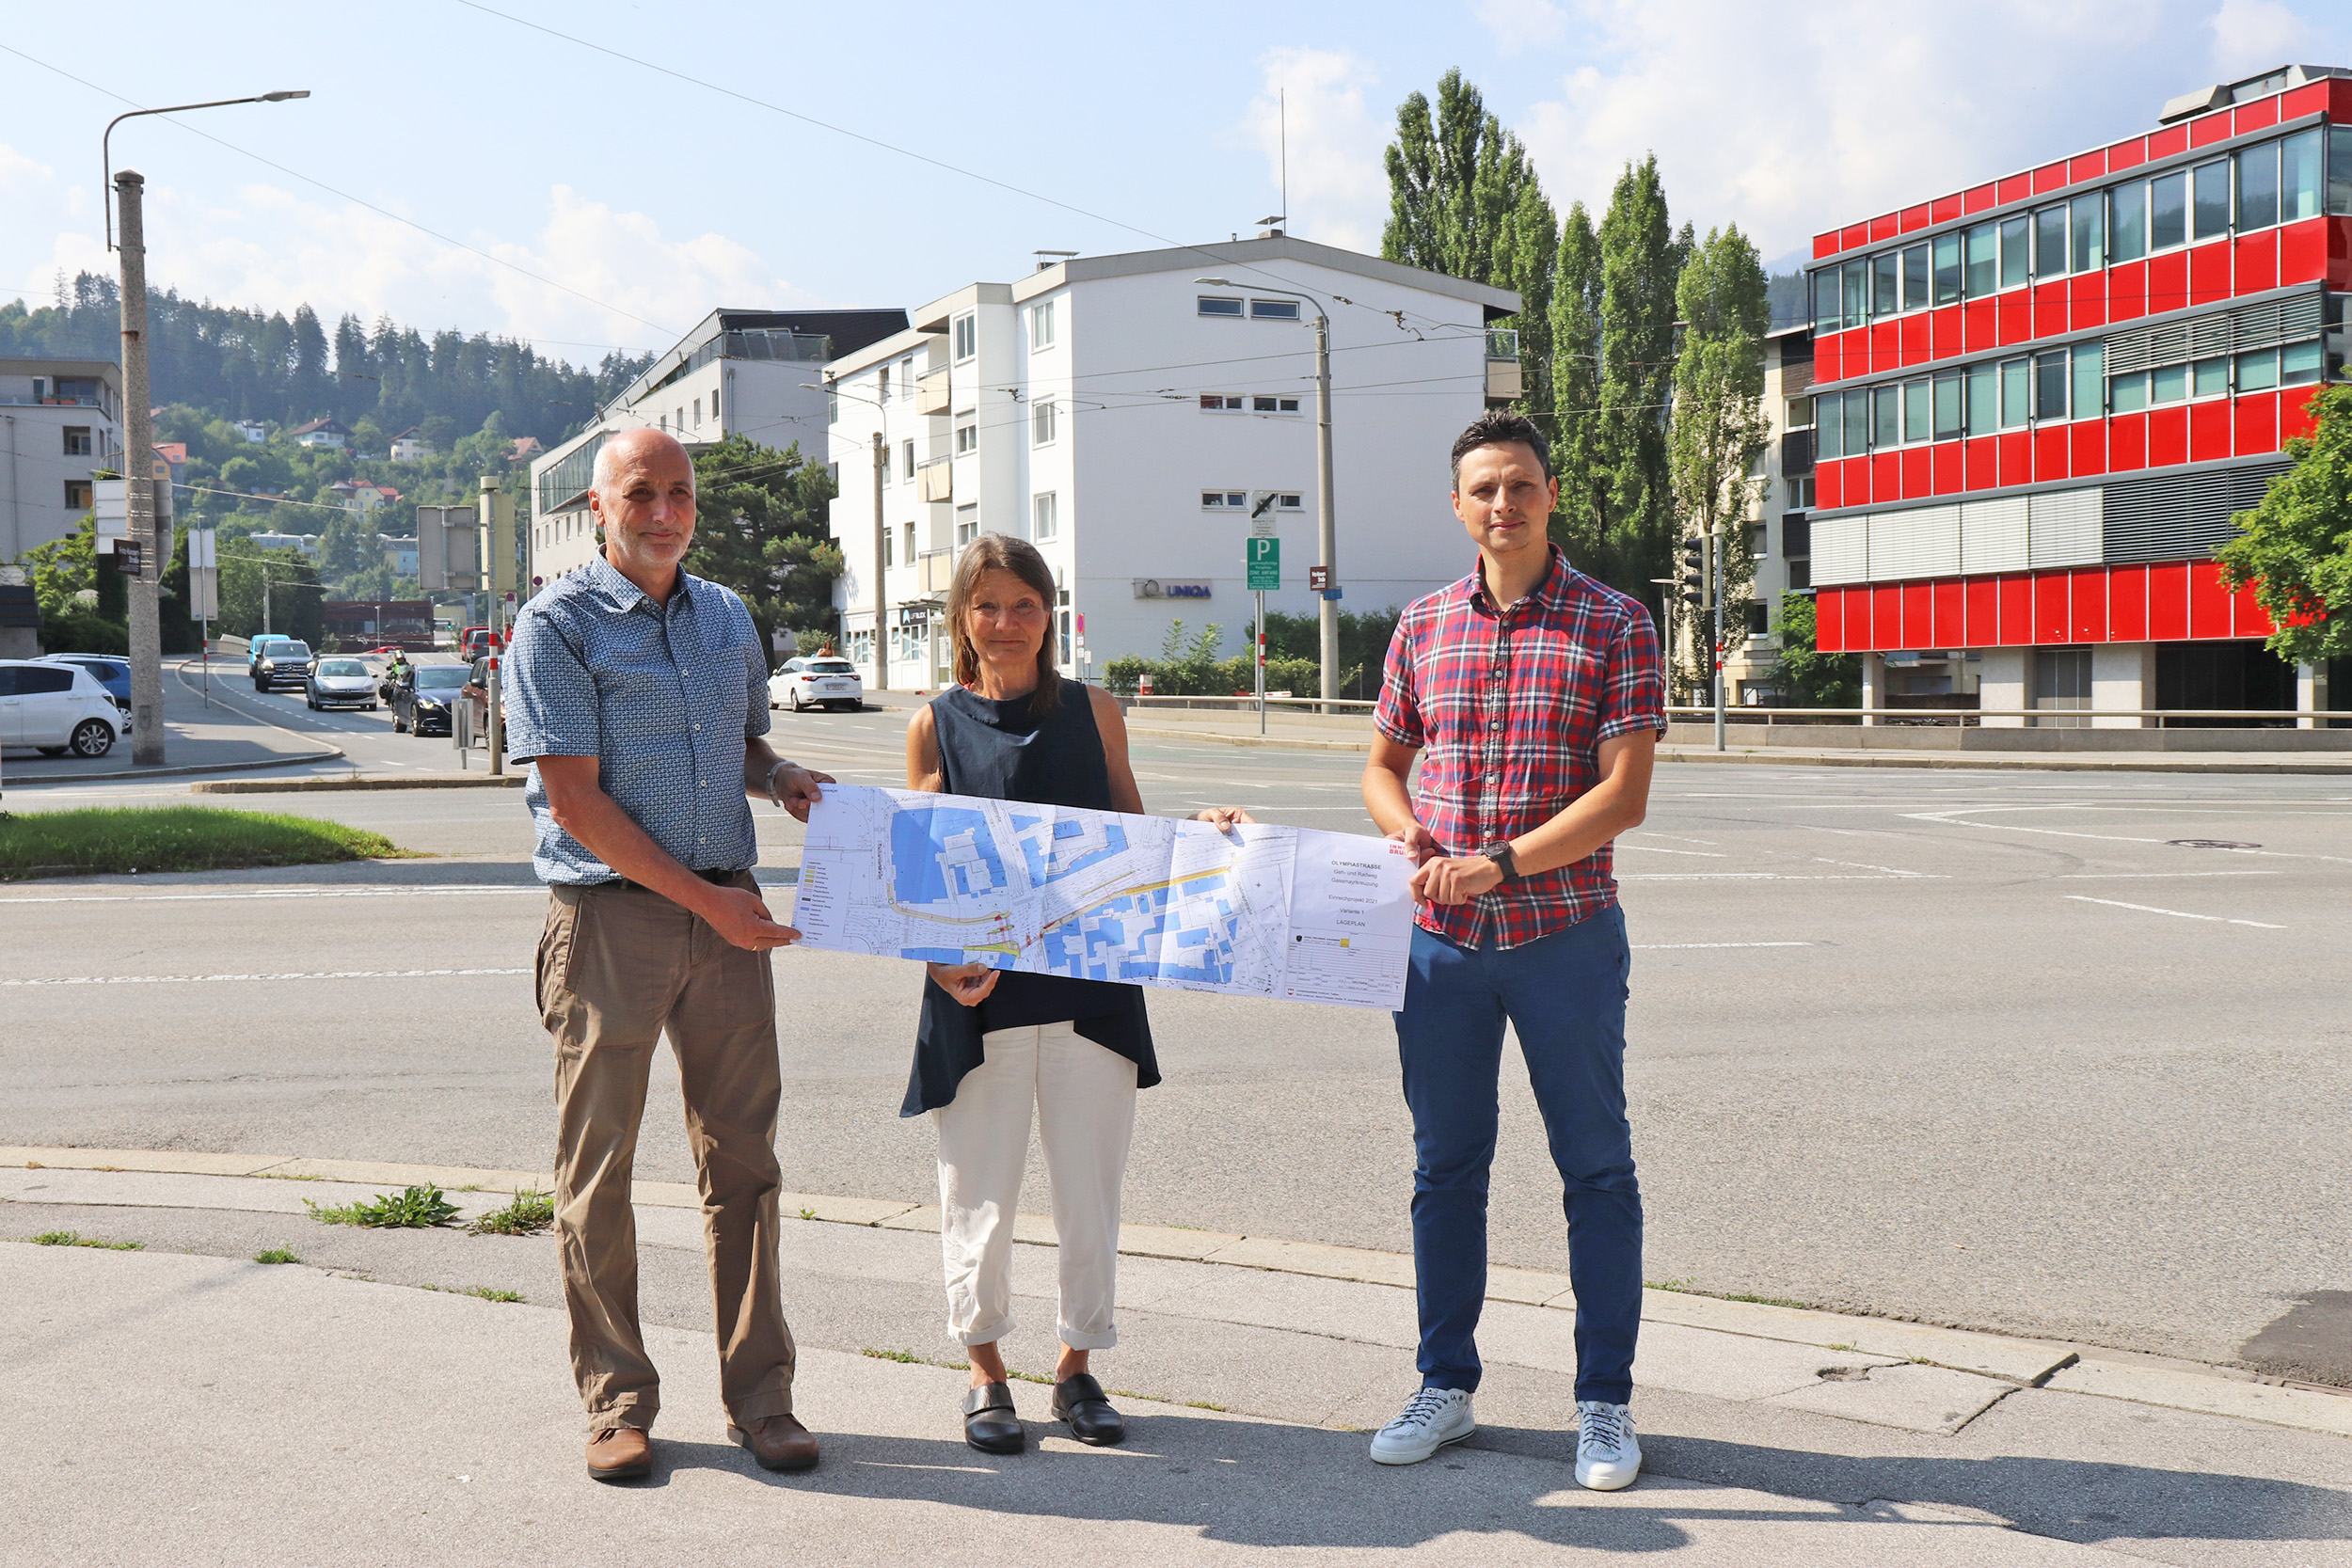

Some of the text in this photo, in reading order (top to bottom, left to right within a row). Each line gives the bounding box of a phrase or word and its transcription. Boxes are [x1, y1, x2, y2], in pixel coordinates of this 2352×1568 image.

[1257, 539, 1271, 562] P
[1168, 585, 1212, 597] UNIQA
[1331, 860, 1381, 870] OLYMPIASTRASSE
[1358, 871, 1377, 879] Radweg
[1328, 895, 1364, 903] Einreichprojekt
